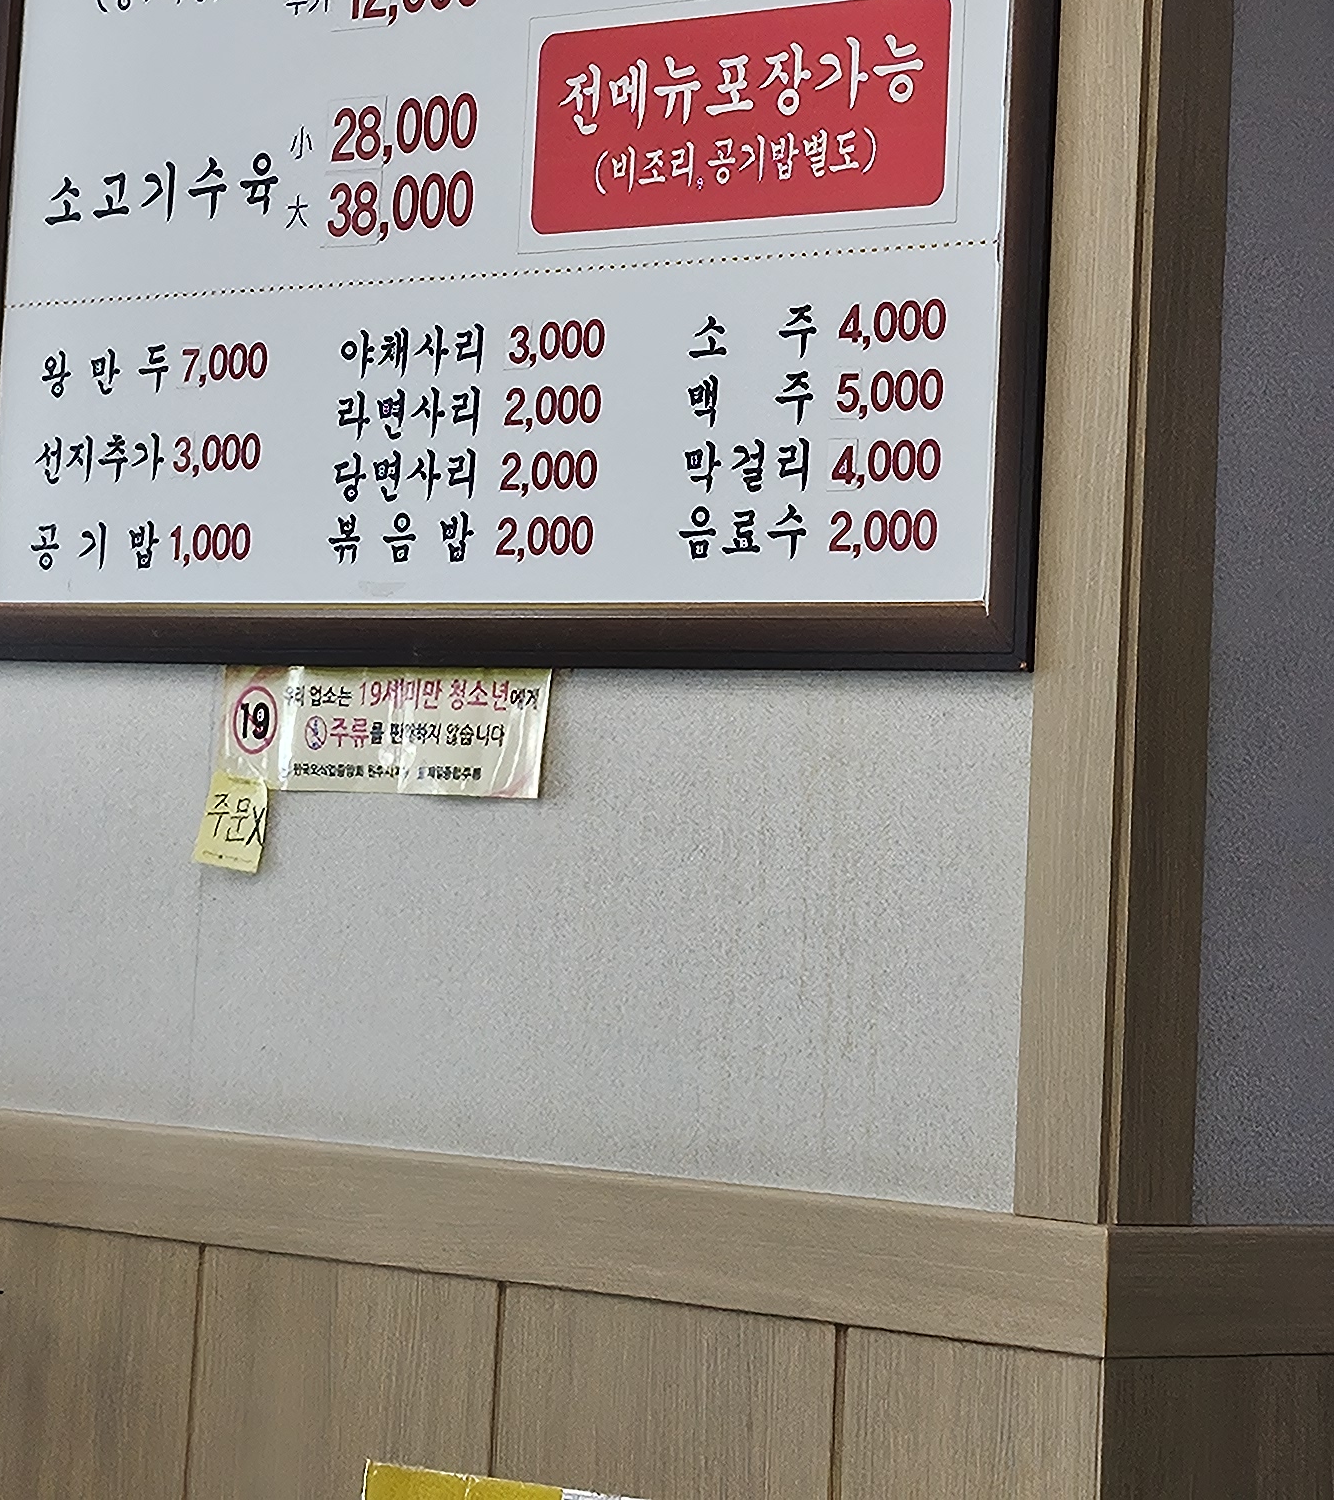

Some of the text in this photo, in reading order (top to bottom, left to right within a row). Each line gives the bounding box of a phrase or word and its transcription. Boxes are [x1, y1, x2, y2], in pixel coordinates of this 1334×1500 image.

[330, 92, 478, 168] 28,000
[44, 152, 279, 226] 소고기수육
[285, 170, 474, 245] 大 38,000
[340, 318, 606, 380] 야채사리 3,000
[838, 298, 947, 351] 4,000
[182, 341, 268, 388] 7,000
[337, 384, 602, 441] 라면사리 2,000
[836, 368, 944, 420] 5,000
[34, 432, 261, 485] 선지추가 3,000
[333, 447, 598, 503] 당면사리 2,000
[684, 437, 942, 494] 막걸리 4,000
[169, 522, 251, 568] 1,000
[495, 515, 594, 563] 2,000
[678, 503, 938, 560] 음료수 2,000
[239, 701, 270, 741] 19
[309, 685, 353, 707] 업소는
[330, 717, 384, 748] 주류를
[446, 722, 506, 747] 않습니다
